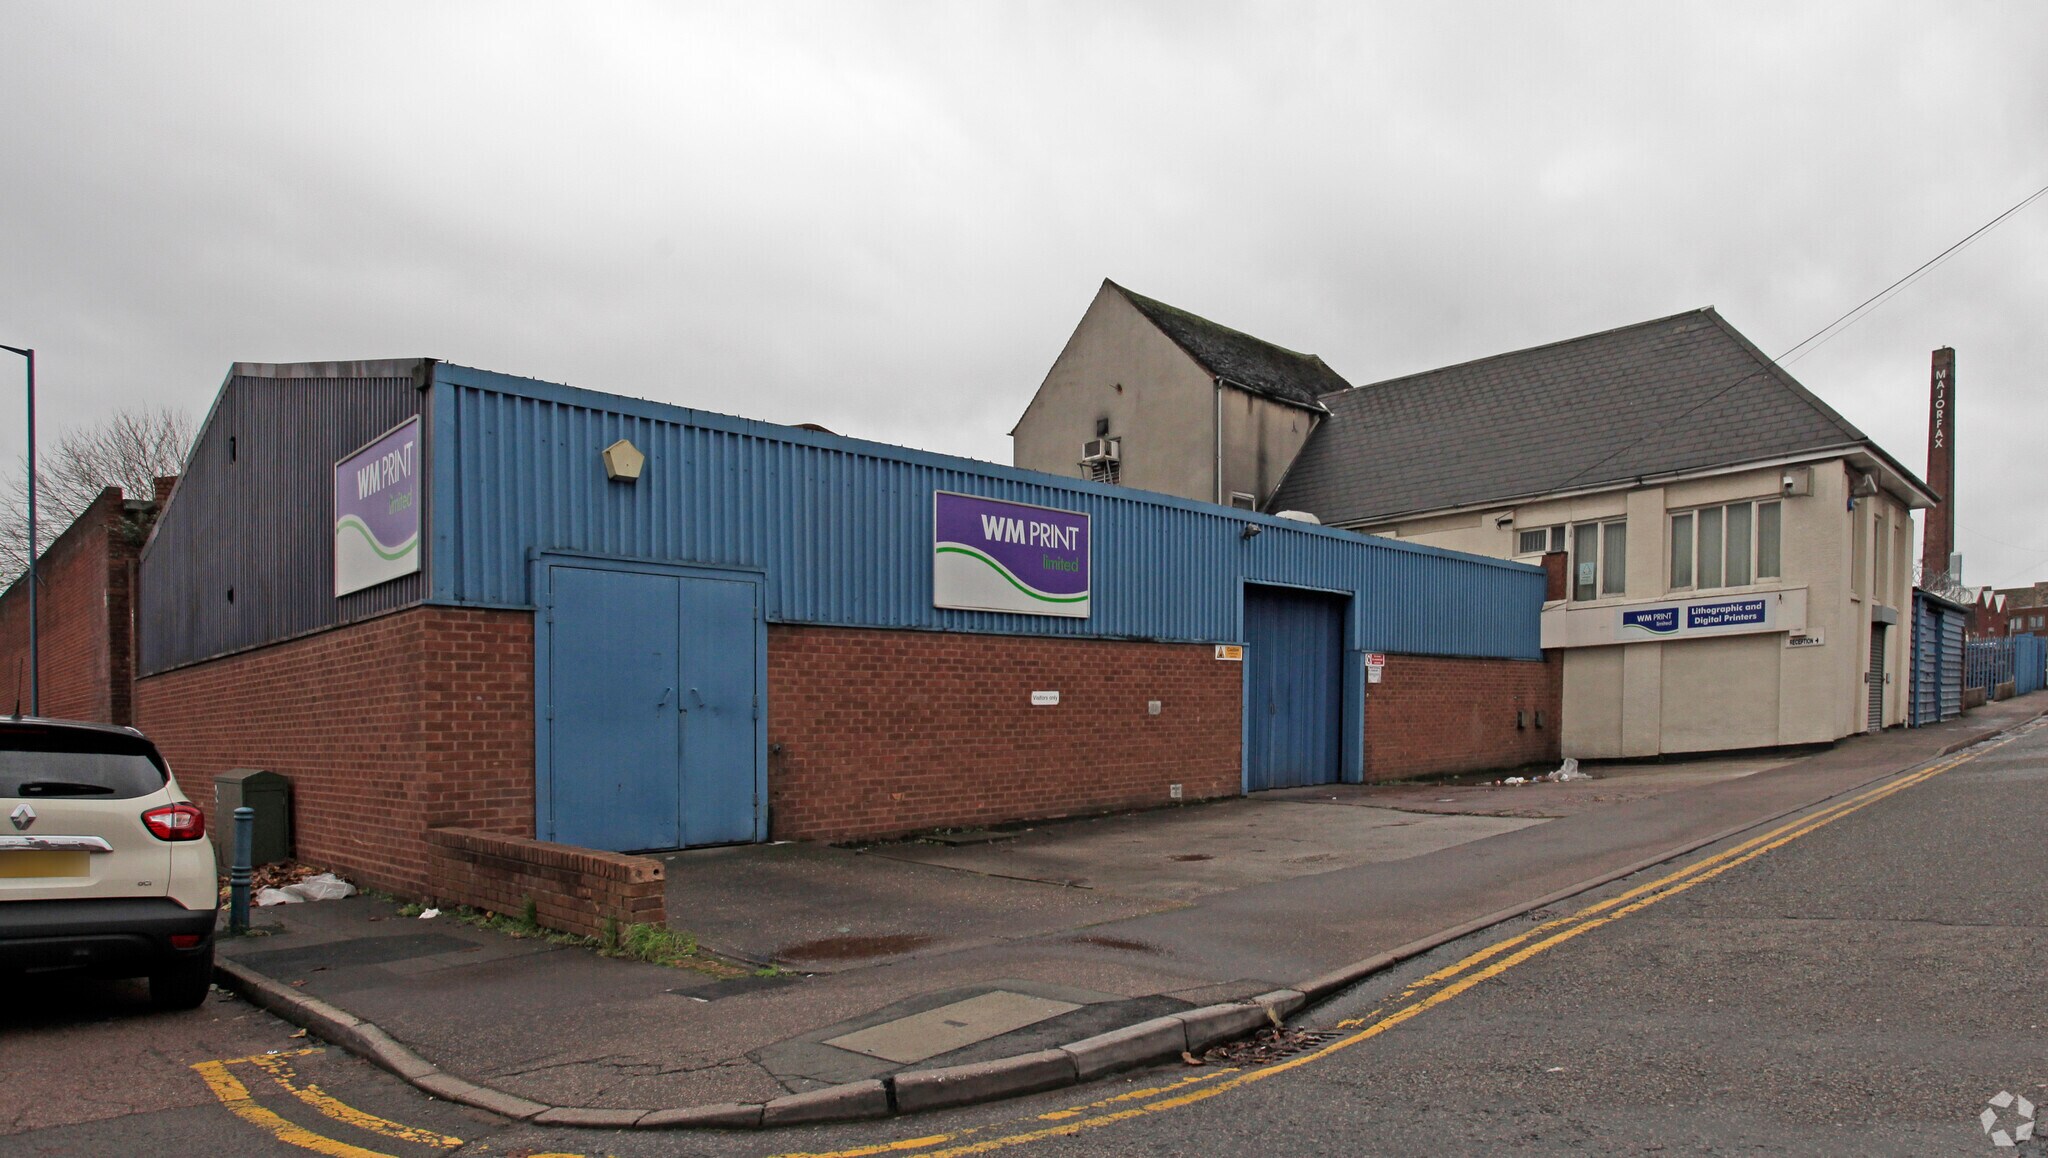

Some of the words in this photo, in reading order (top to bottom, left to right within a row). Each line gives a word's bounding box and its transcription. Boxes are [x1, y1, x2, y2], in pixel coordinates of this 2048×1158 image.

[1935, 369, 1946, 448] MAJORFAX
[357, 460, 381, 500] WM
[382, 441, 414, 489] PRINT
[388, 483, 413, 515] limited
[981, 514, 1026, 545] WM
[1030, 521, 1079, 551] PRINT
[1043, 554, 1079, 572] limited
[1637, 614, 1652, 622] WM
[1653, 612, 1672, 621] PRINT
[1691, 604, 1743, 615] Lithographic
[1745, 602, 1762, 611] and
[1694, 615, 1721, 625] Digital
[1724, 613, 1757, 622] Printers
[1790, 637, 1813, 646] RECEPTION
